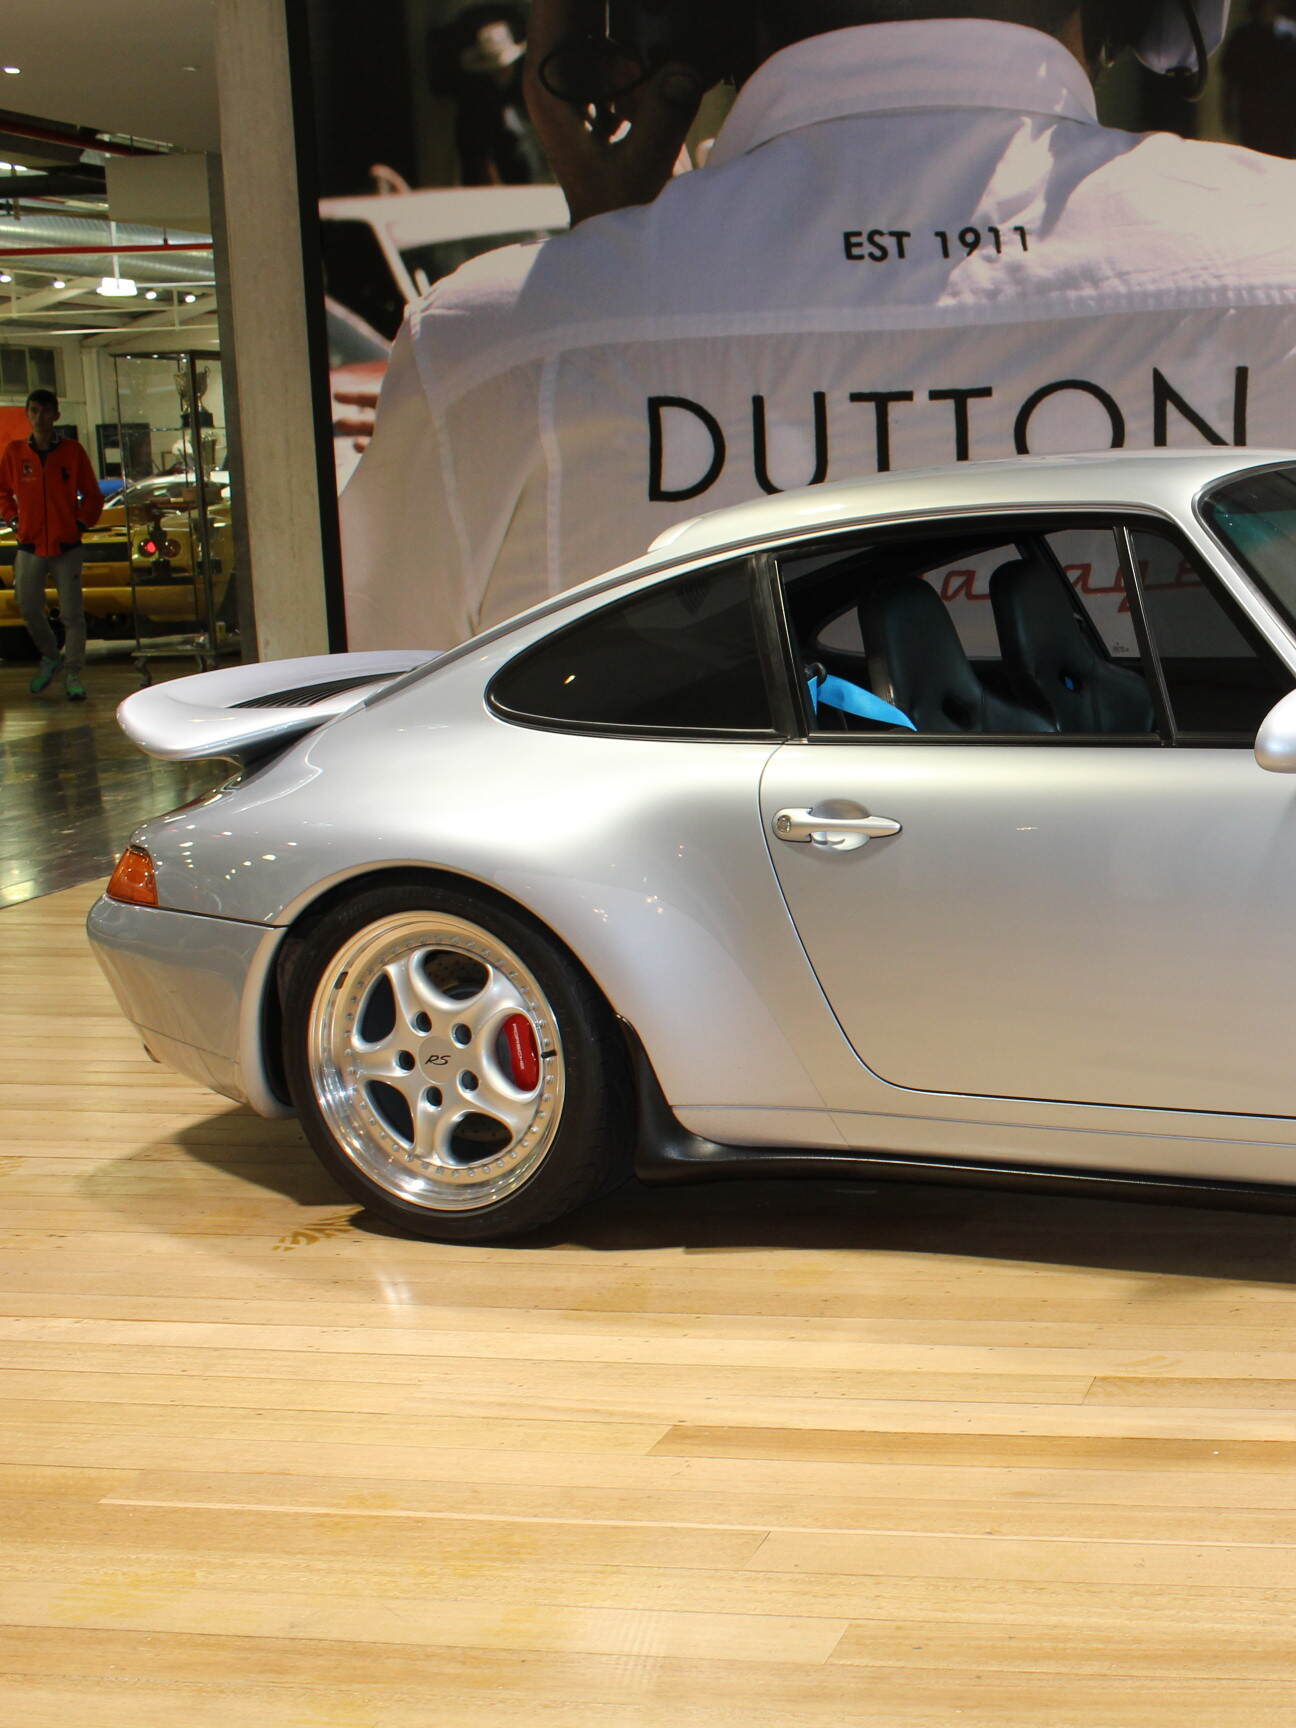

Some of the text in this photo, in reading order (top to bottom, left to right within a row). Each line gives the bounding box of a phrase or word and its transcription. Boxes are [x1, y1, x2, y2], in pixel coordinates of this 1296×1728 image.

[843, 225, 1030, 262] EST 1911
[648, 365, 1249, 502] DUTTON
[424, 1054, 452, 1066] RS
